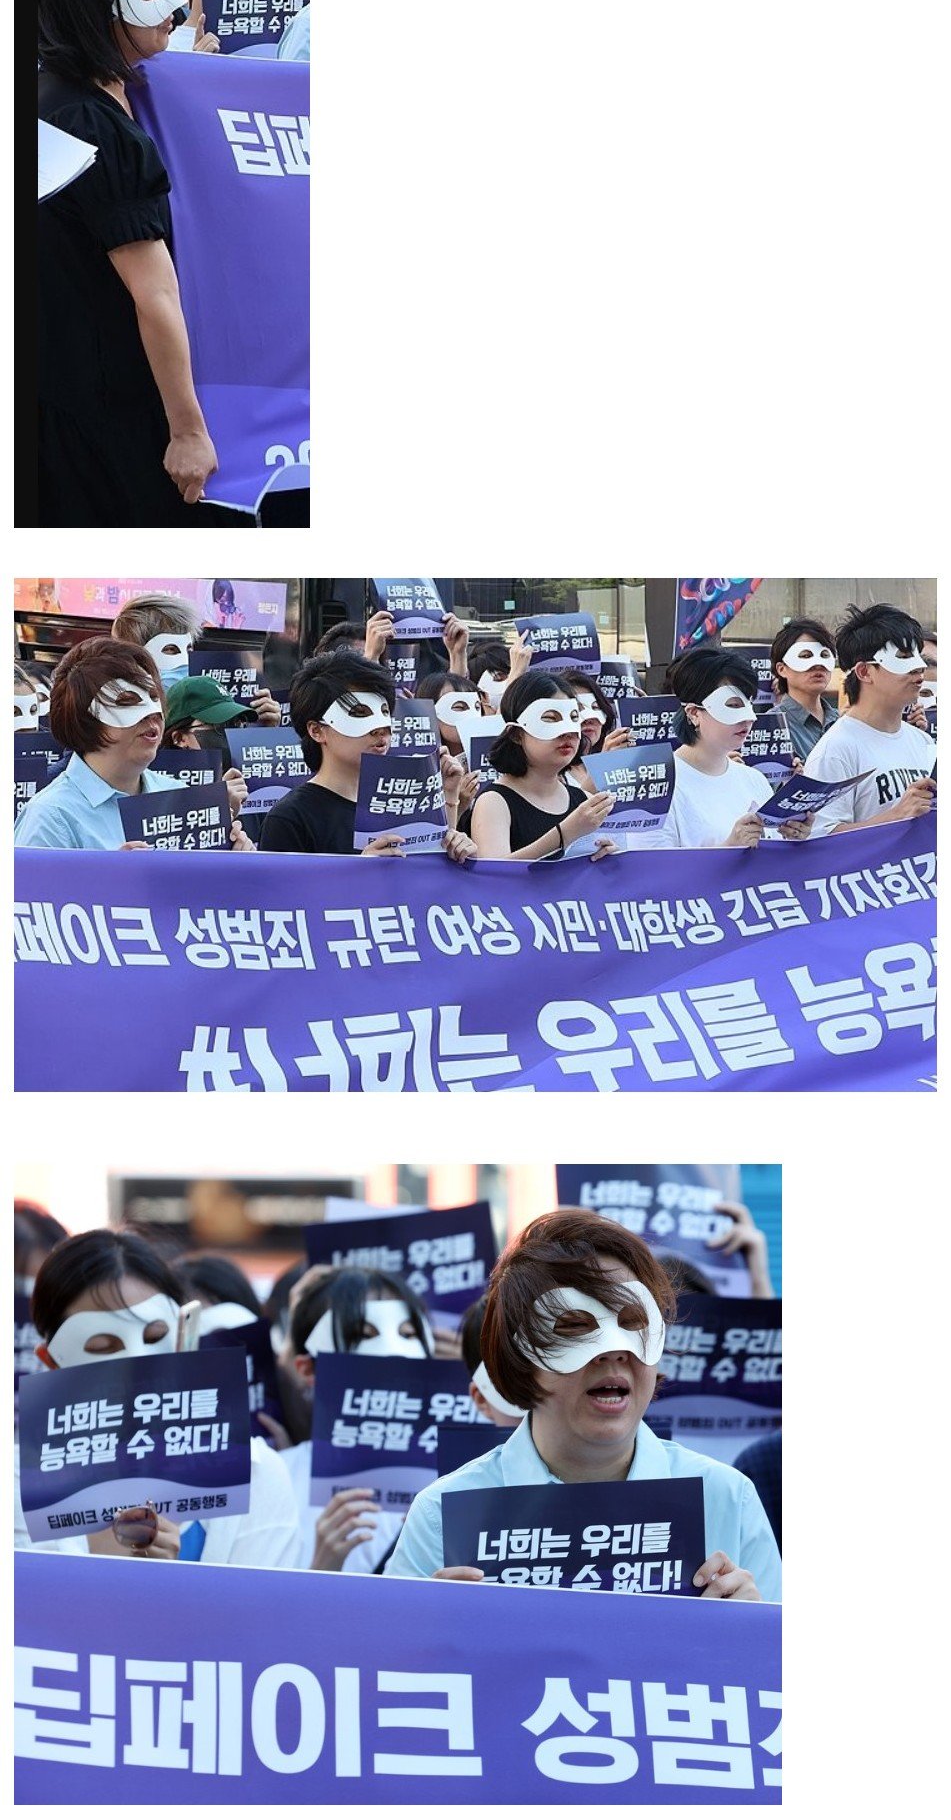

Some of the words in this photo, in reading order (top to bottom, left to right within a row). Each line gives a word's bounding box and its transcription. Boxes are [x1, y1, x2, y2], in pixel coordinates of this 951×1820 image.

[217, 17, 264, 36] 능욕할
[268, 17, 282, 33] 수
[404, 717, 431, 731] 우리를
[241, 764, 273, 779] 능욕할
[376, 777, 424, 794] 너희는
[604, 768, 636, 786] 너희는
[639, 763, 666, 780] 우리를
[369, 796, 416, 815] 능욕할
[418, 795, 432, 809] 수
[142, 814, 183, 837] 너희는
[186, 807, 222, 828] 우리를
[184, 834, 197, 850] 수
[174, 906, 317, 971] 성범죄
[323, 904, 421, 969] 규탄
[426, 903, 521, 956] 여성
[721, 880, 811, 938] 긴급
[537, 977, 795, 1092] 우리를
[46, 1399, 124, 1436] 너희는
[132, 1388, 219, 1424] 우리를
[341, 1388, 423, 1420] 너희는
[40, 1433, 119, 1472] 능욕할
[126, 1430, 155, 1460] 수
[164, 1423, 230, 1457] 없다!
[332, 1420, 413, 1452] 능욕할
[47, 1510, 98, 1530] 딥페이크
[176, 1493, 228, 1512] 공동행동
[476, 1525, 571, 1562] 너희는
[580, 1521, 672, 1557] 우리를
[14, 1643, 483, 1780] 딥페이크
